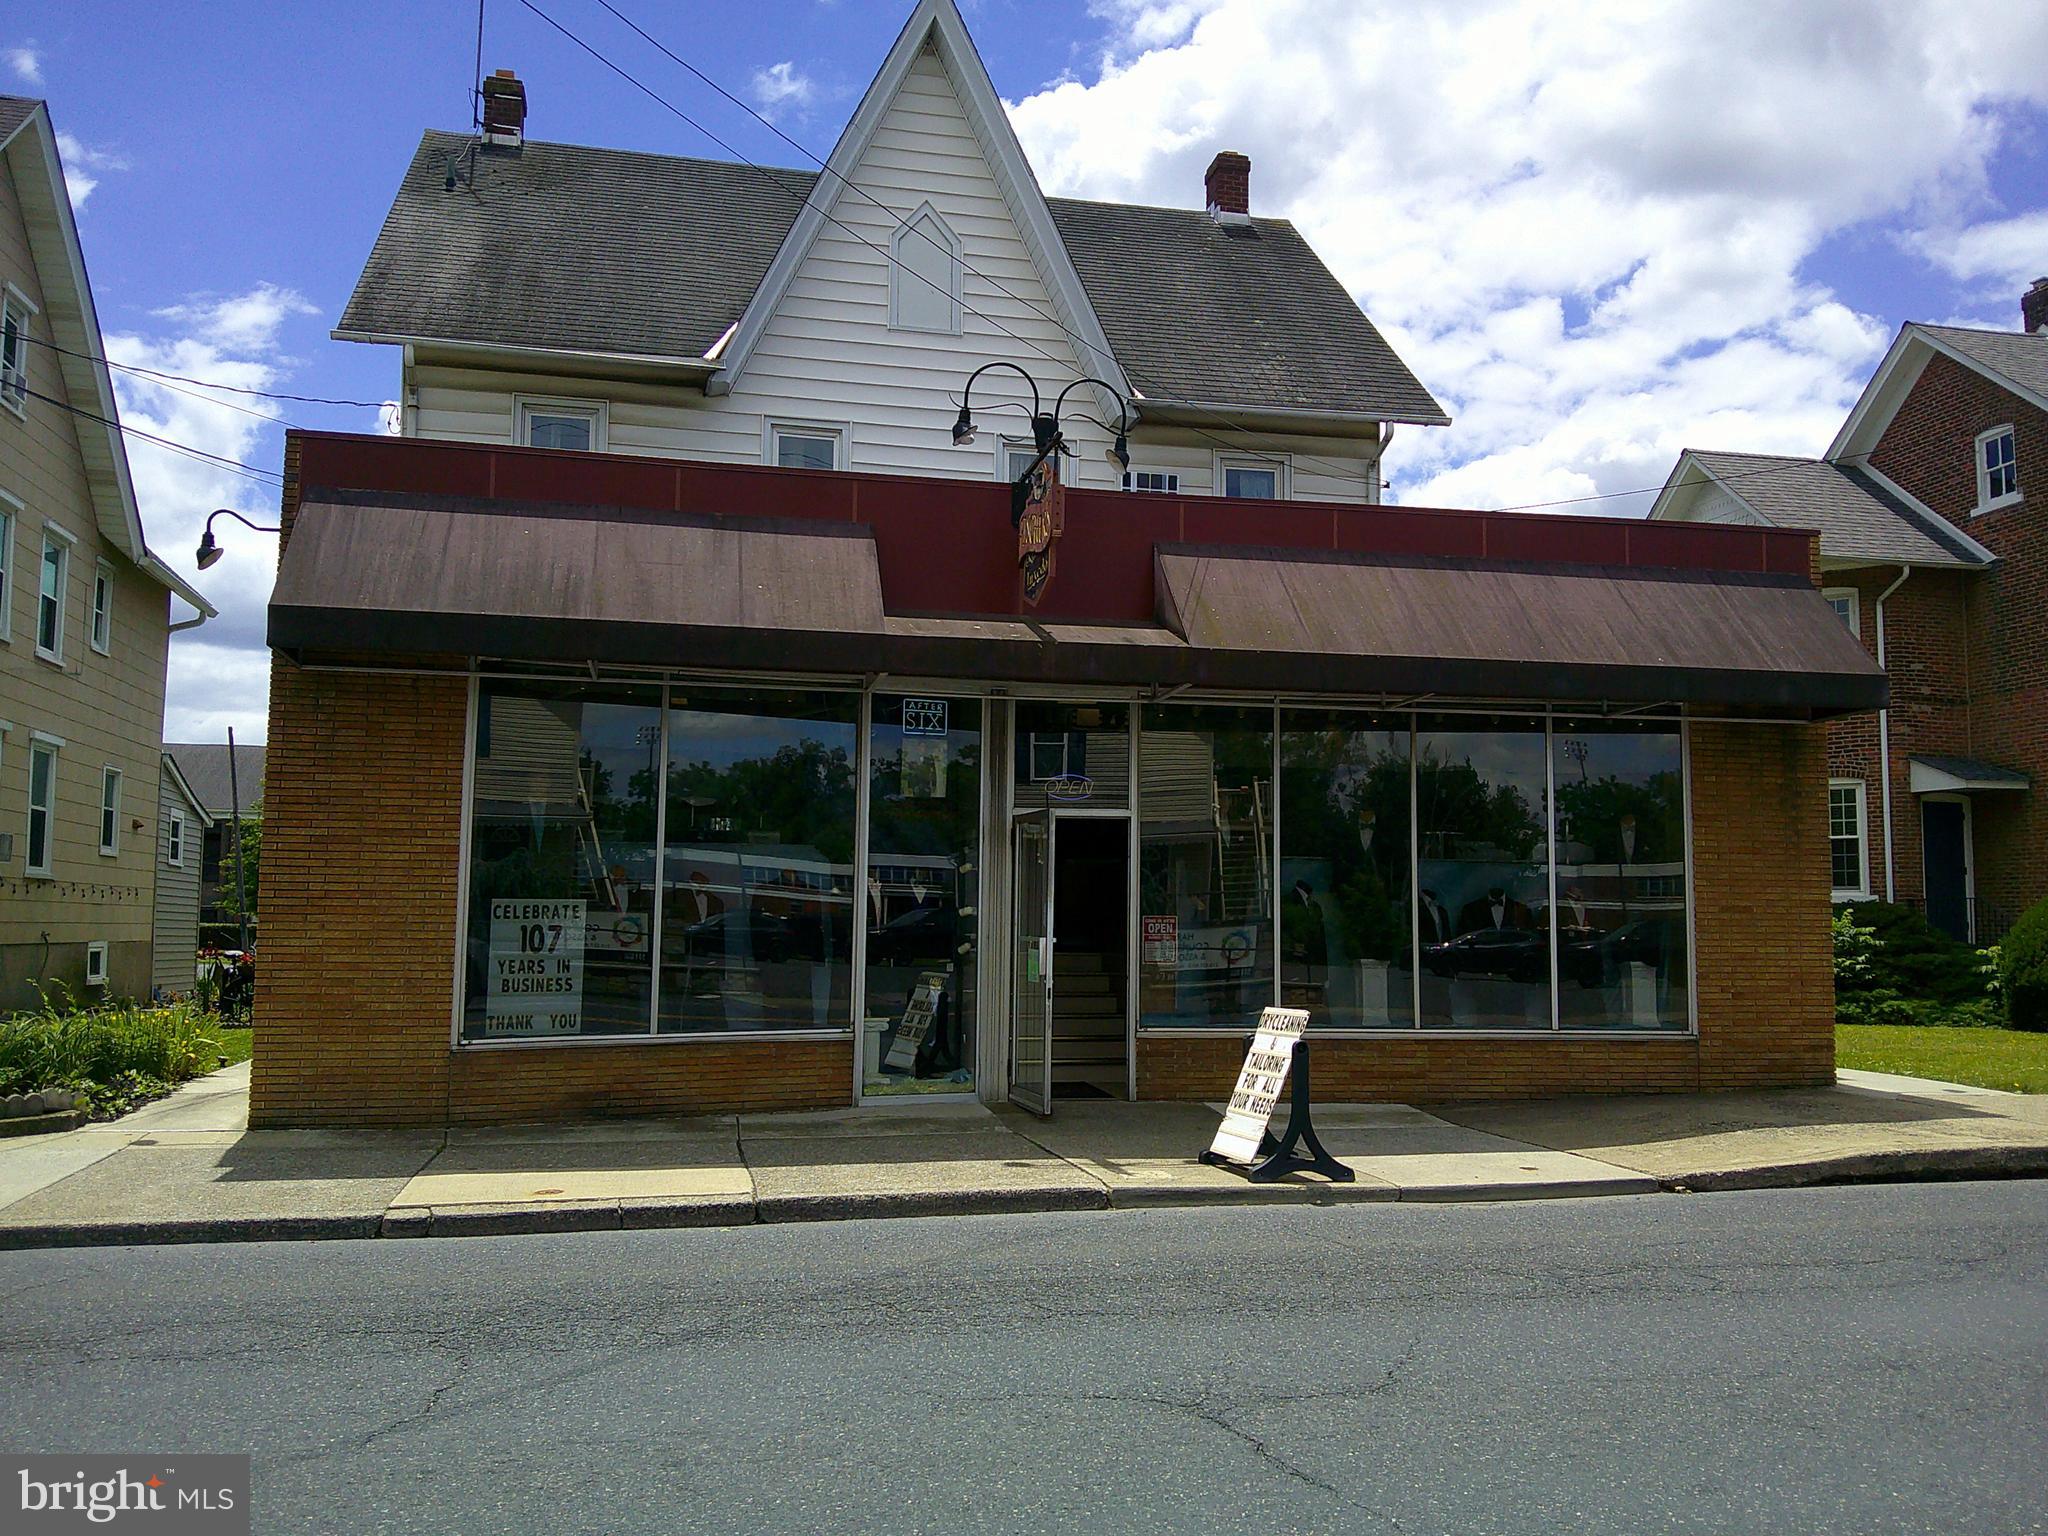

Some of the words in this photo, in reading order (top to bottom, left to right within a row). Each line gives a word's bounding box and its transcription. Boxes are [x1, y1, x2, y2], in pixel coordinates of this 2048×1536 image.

[908, 702, 943, 712] AFTER
[906, 712, 943, 730] SIX
[1044, 780, 1094, 794] OPEN
[493, 904, 580, 920] CELEBRATE
[1148, 923, 1173, 933] OPEN
[520, 924, 563, 953] 107
[498, 959, 545, 975] YEARS
[557, 959, 571, 974] IN
[501, 977, 573, 993] BUSINESS
[487, 1014, 534, 1031] THANK
[550, 1013, 577, 1029] YOU
[1259, 1014, 1307, 1033] DRYCLEANING
[1248, 1053, 1286, 1073] TAILORING
[1242, 1074, 1259, 1090] FOR
[1262, 1078, 1278, 1094] ALL
[1230, 1092, 1250, 1110] YOUR
[1250, 1096, 1275, 1115] NEEDS
